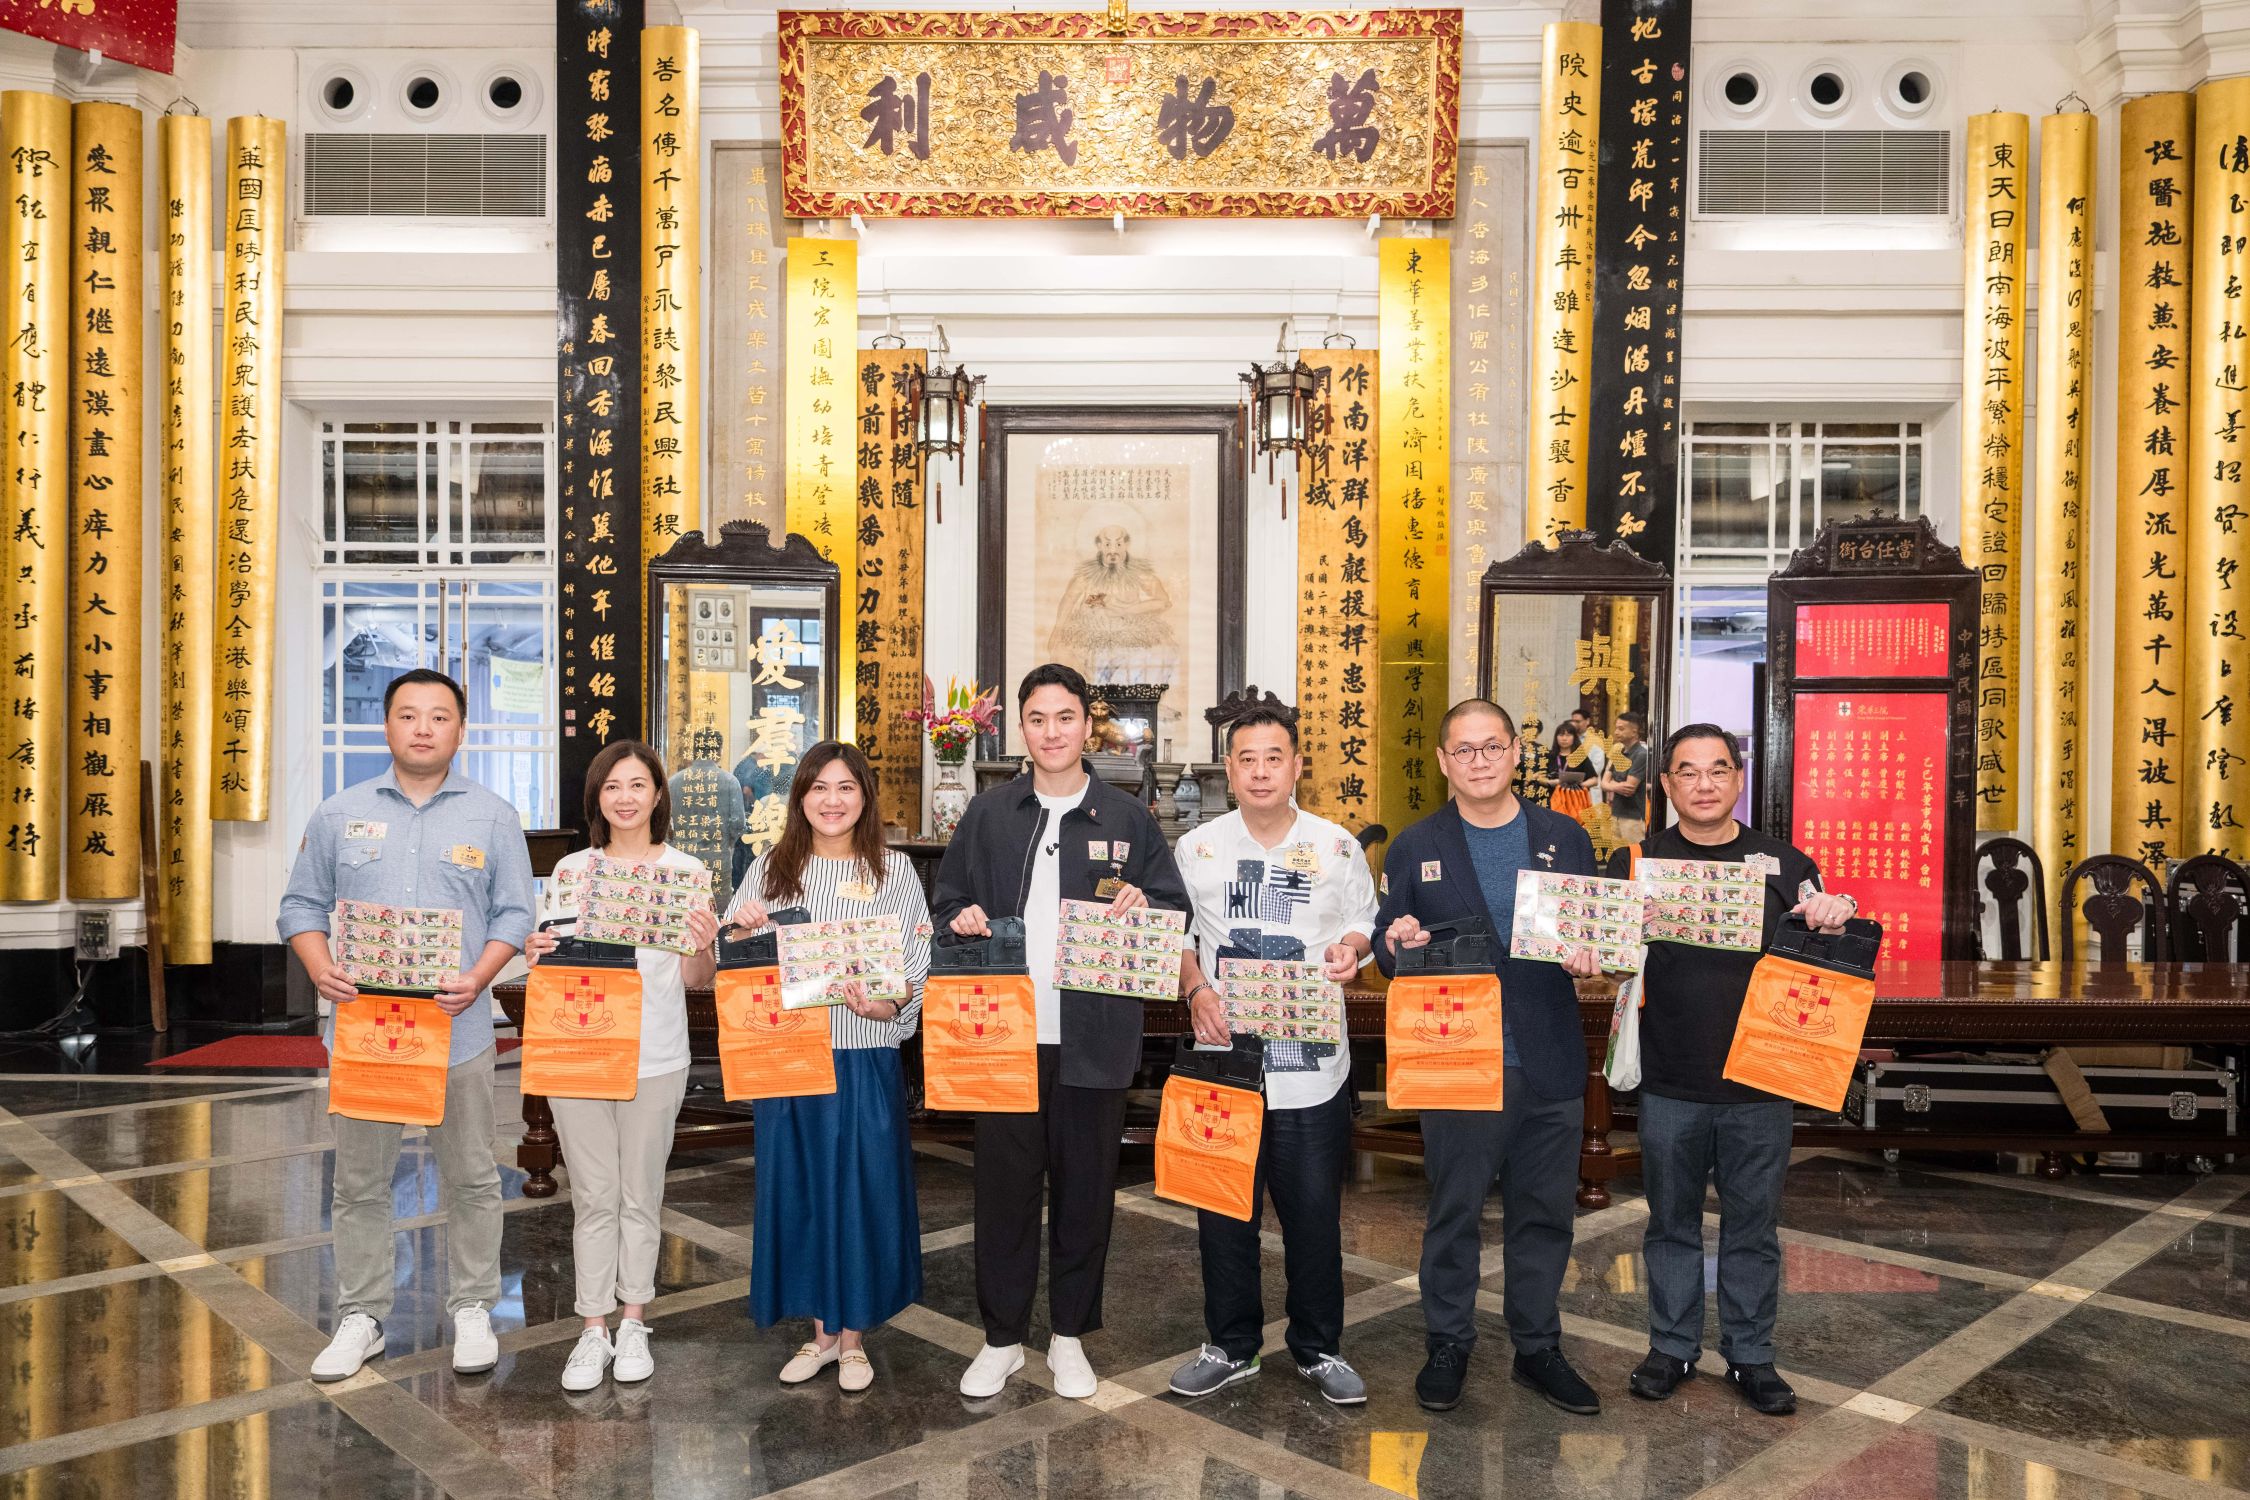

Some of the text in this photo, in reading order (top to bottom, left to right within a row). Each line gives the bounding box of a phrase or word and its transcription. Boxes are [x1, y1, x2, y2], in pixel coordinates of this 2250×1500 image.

[860, 68, 1382, 167] 萬物咸利
[1976, 142, 2017, 804] 東天日朗南海波平繁榮穩定證回歸特區同歌盛世
[1838, 539, 1915, 560] 當任台銜
[1952, 630, 1974, 810] 中華民國二十一年
[1919, 757, 1934, 857] 乙巳年董事局成員
